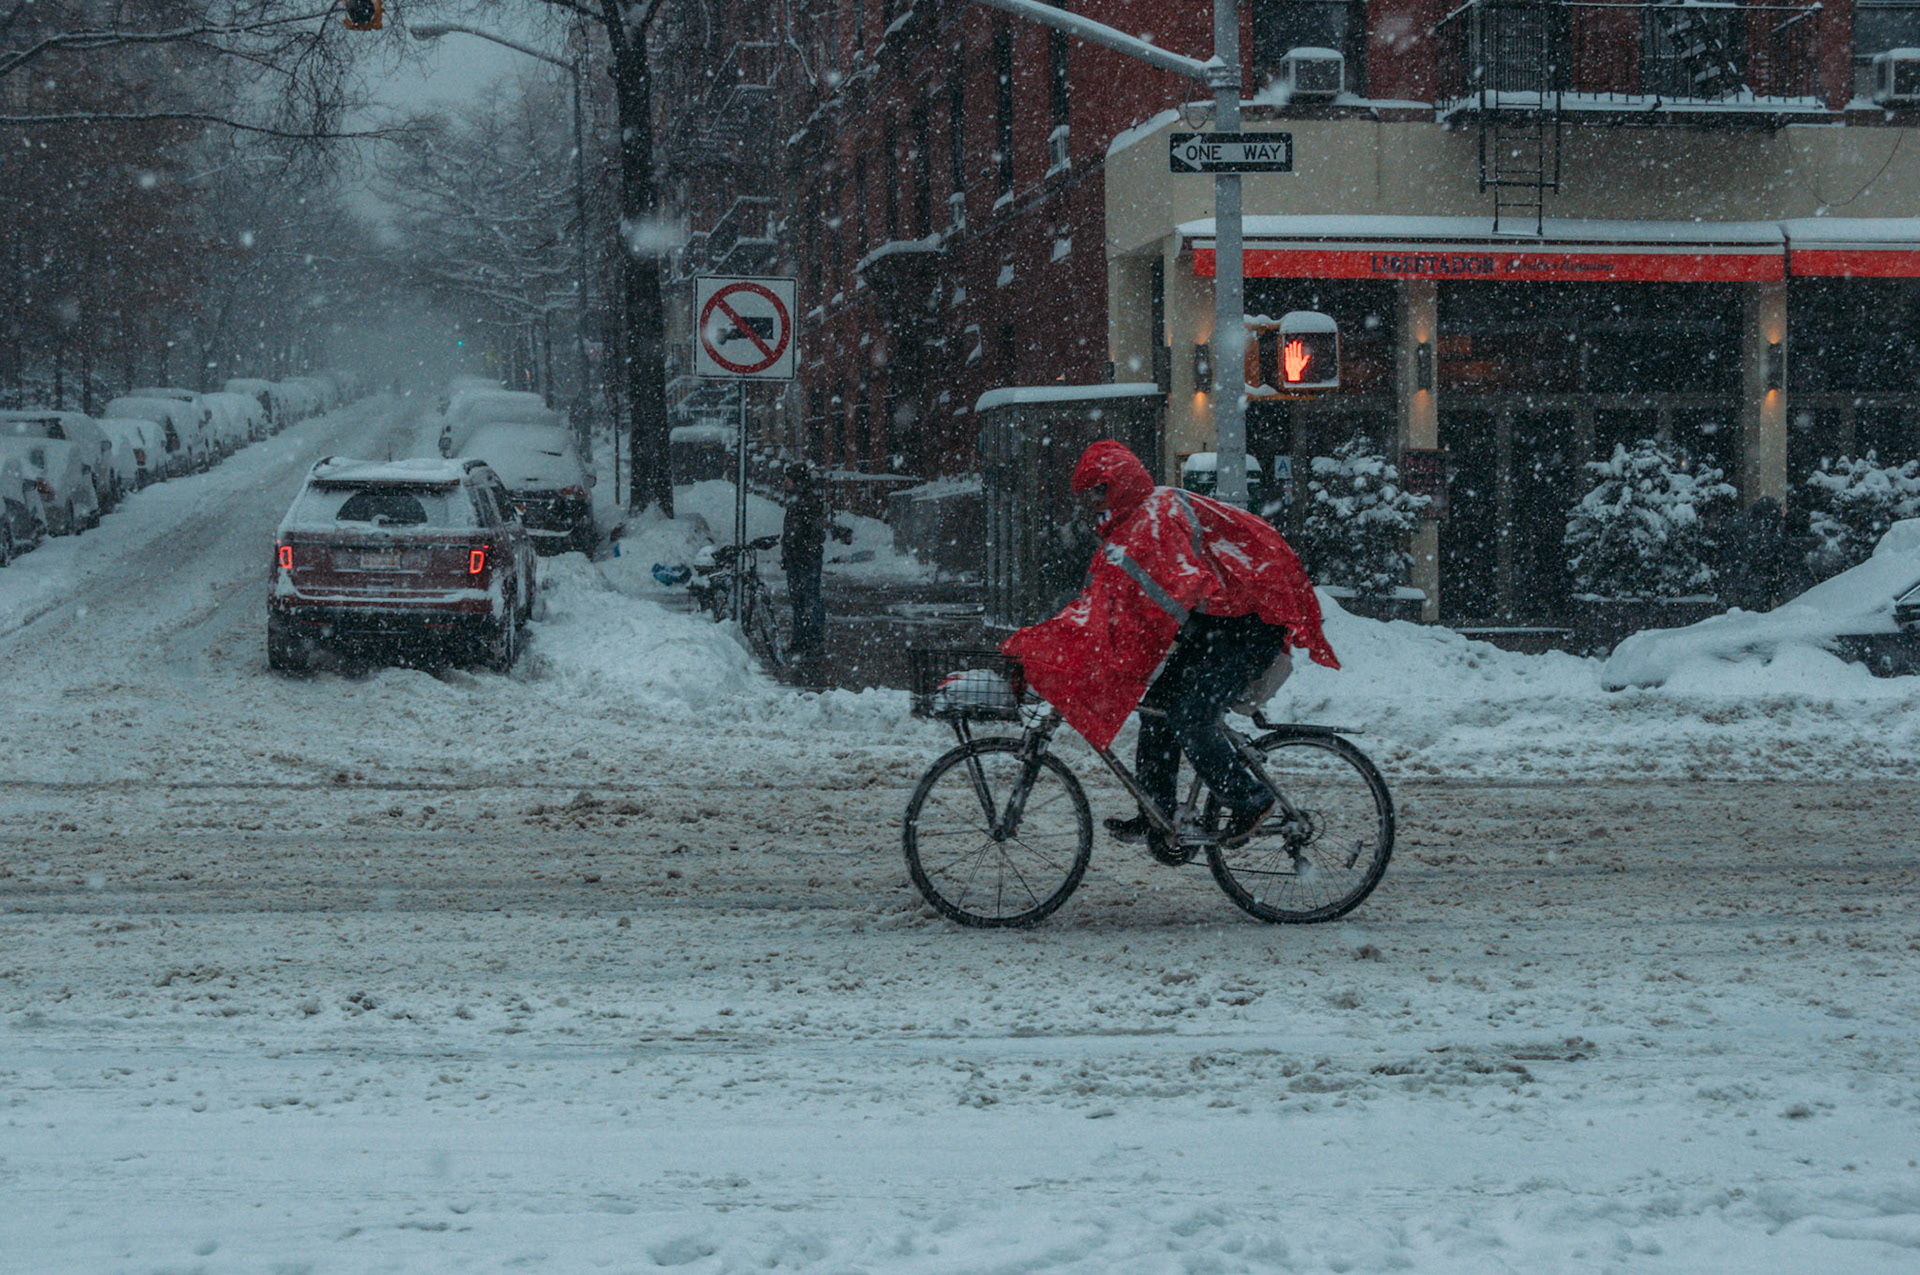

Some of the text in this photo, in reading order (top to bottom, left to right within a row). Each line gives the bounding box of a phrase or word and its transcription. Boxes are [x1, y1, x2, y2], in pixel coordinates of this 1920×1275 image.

[1186, 145, 1281, 161] ONE WAY
[1371, 256, 1494, 274] LIBERTADOR
[1278, 459, 1289, 472] A
